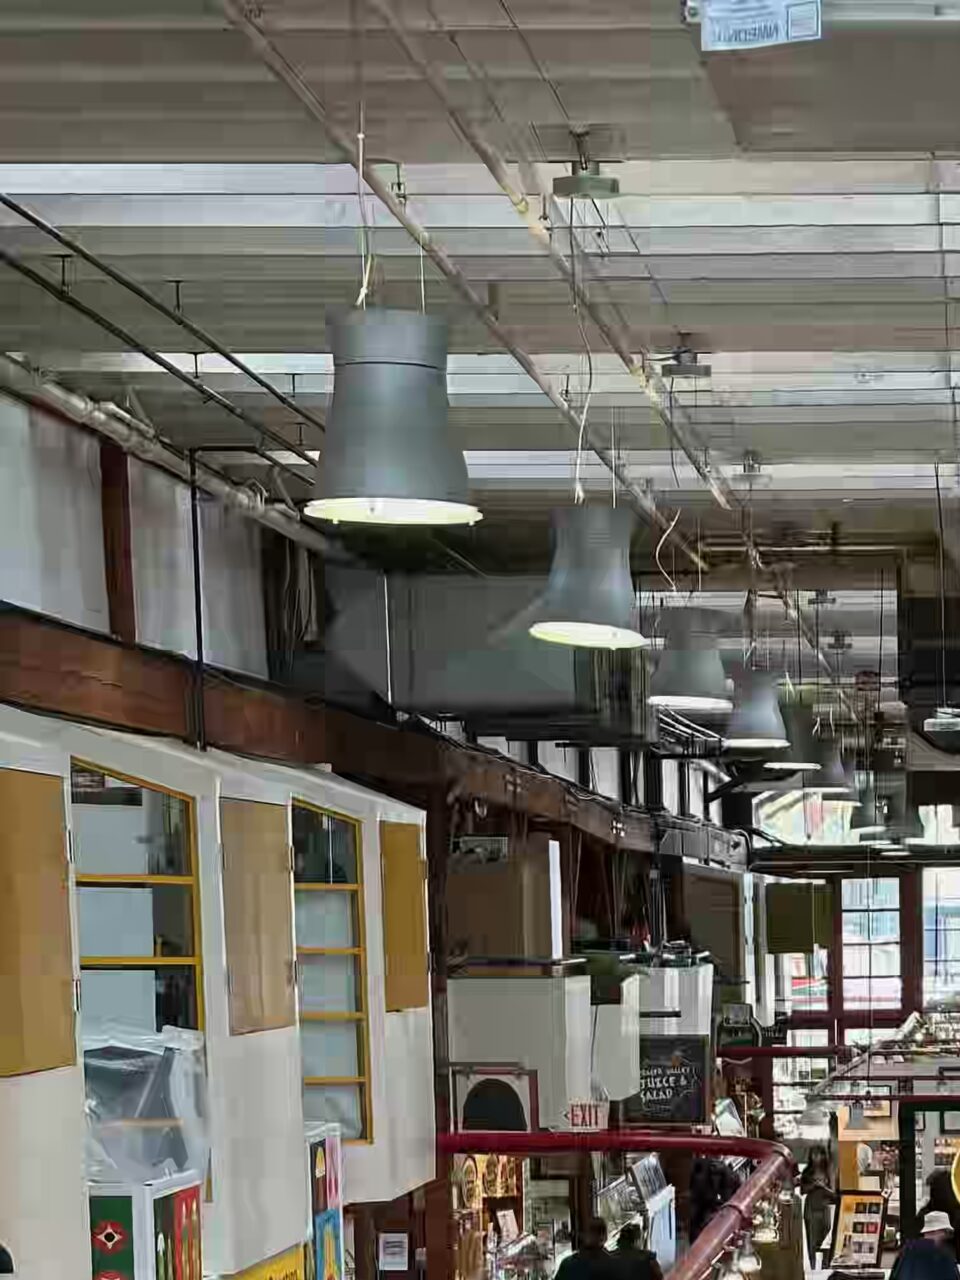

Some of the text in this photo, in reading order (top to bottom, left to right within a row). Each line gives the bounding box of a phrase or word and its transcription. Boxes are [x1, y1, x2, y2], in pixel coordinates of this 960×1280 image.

[640, 1076, 676, 1089] JUICE
[640, 1089, 673, 1103] SALAD
[571, 1104, 600, 1127] EXIT
